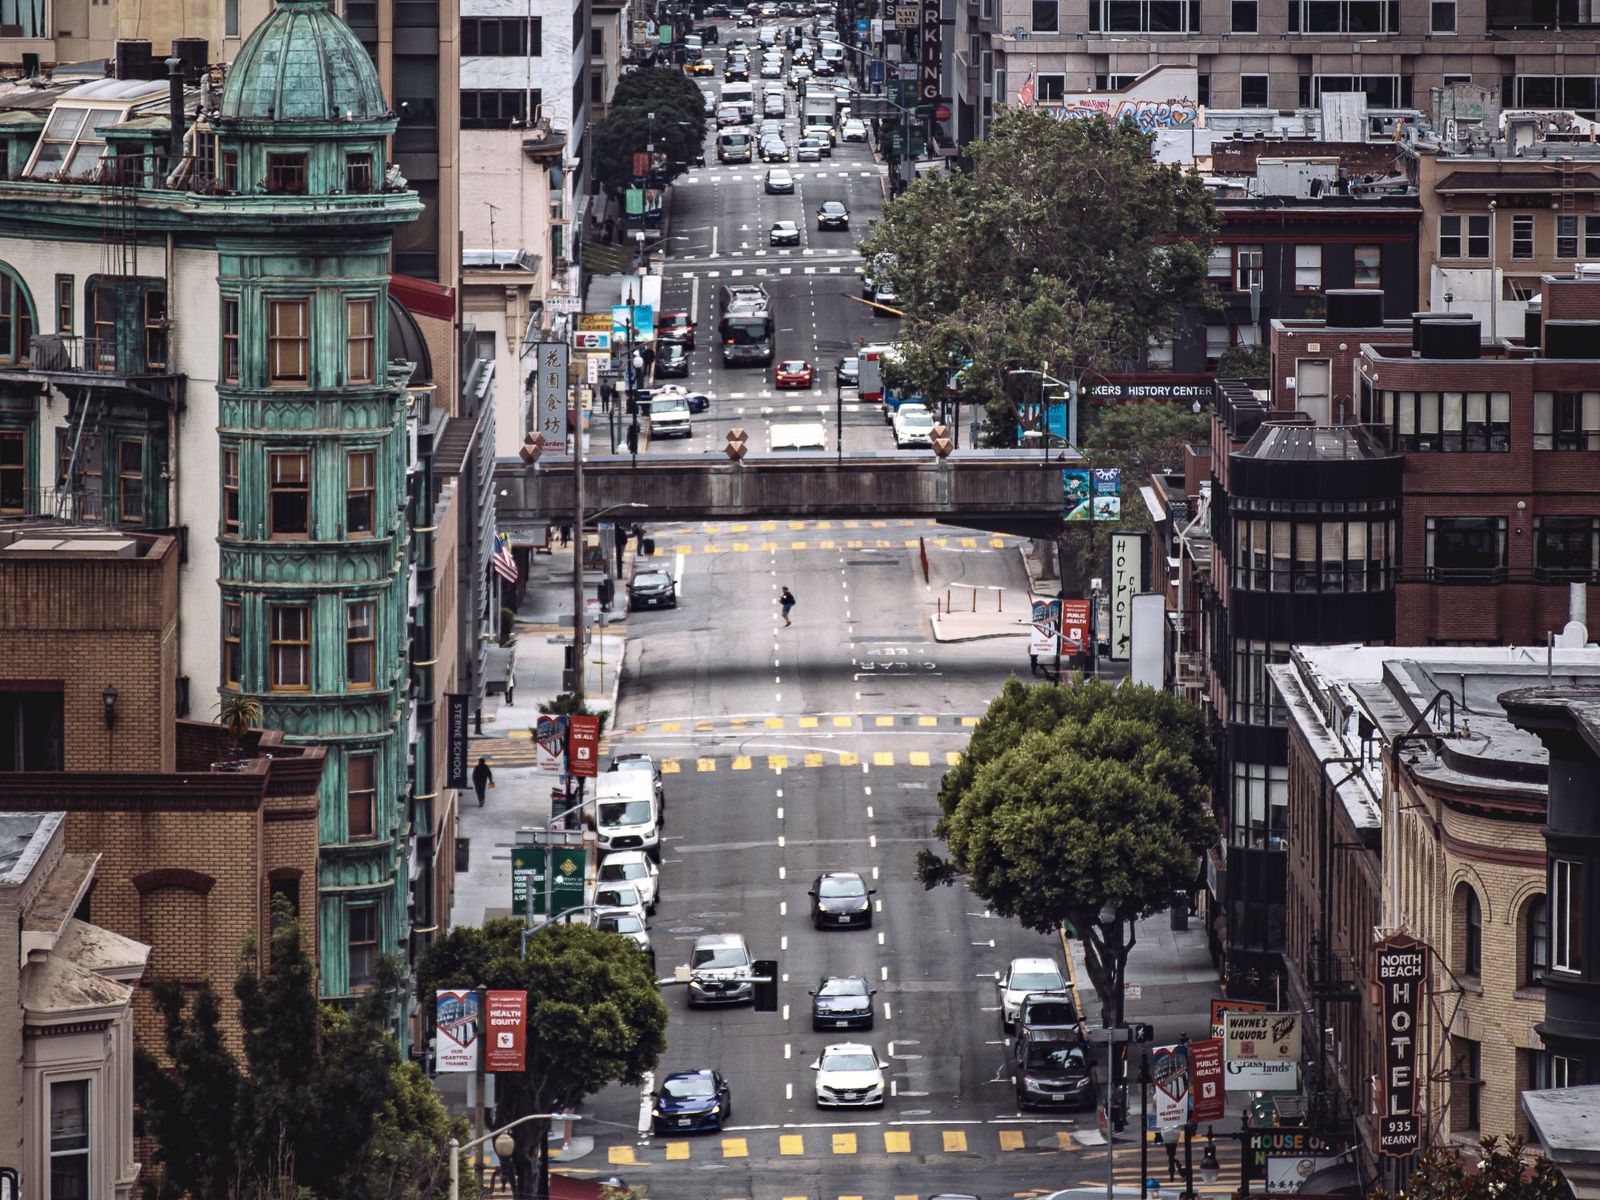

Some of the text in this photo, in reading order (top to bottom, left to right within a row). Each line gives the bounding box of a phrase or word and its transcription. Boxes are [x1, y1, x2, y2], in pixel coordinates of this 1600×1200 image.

[887, 0, 895, 15] S
[544, 348, 561, 434] 花園食坊
[1128, 386, 1171, 396] HISTORY
[1173, 386, 1212, 396] CENTER
[1116, 540, 1126, 628] HOTPOT
[453, 704, 462, 780] STERNE SCHOOL
[1381, 954, 1422, 966] NORTH
[1381, 965, 1422, 978] BEACH
[490, 1010, 521, 1018] HEALTH
[1230, 1017, 1268, 1029] WAYNE'S
[1230, 1031, 1268, 1041] LIQUORS
[1391, 983, 1411, 1116] HOTEL
[1196, 1060, 1219, 1068] PUBLIC
[1196, 1068, 1221, 1077] HEALTH
[1389, 1121, 1411, 1132] 935
[1251, 1135, 1304, 1149] HOUSE
[1381, 1135, 1417, 1146] KEARNY
